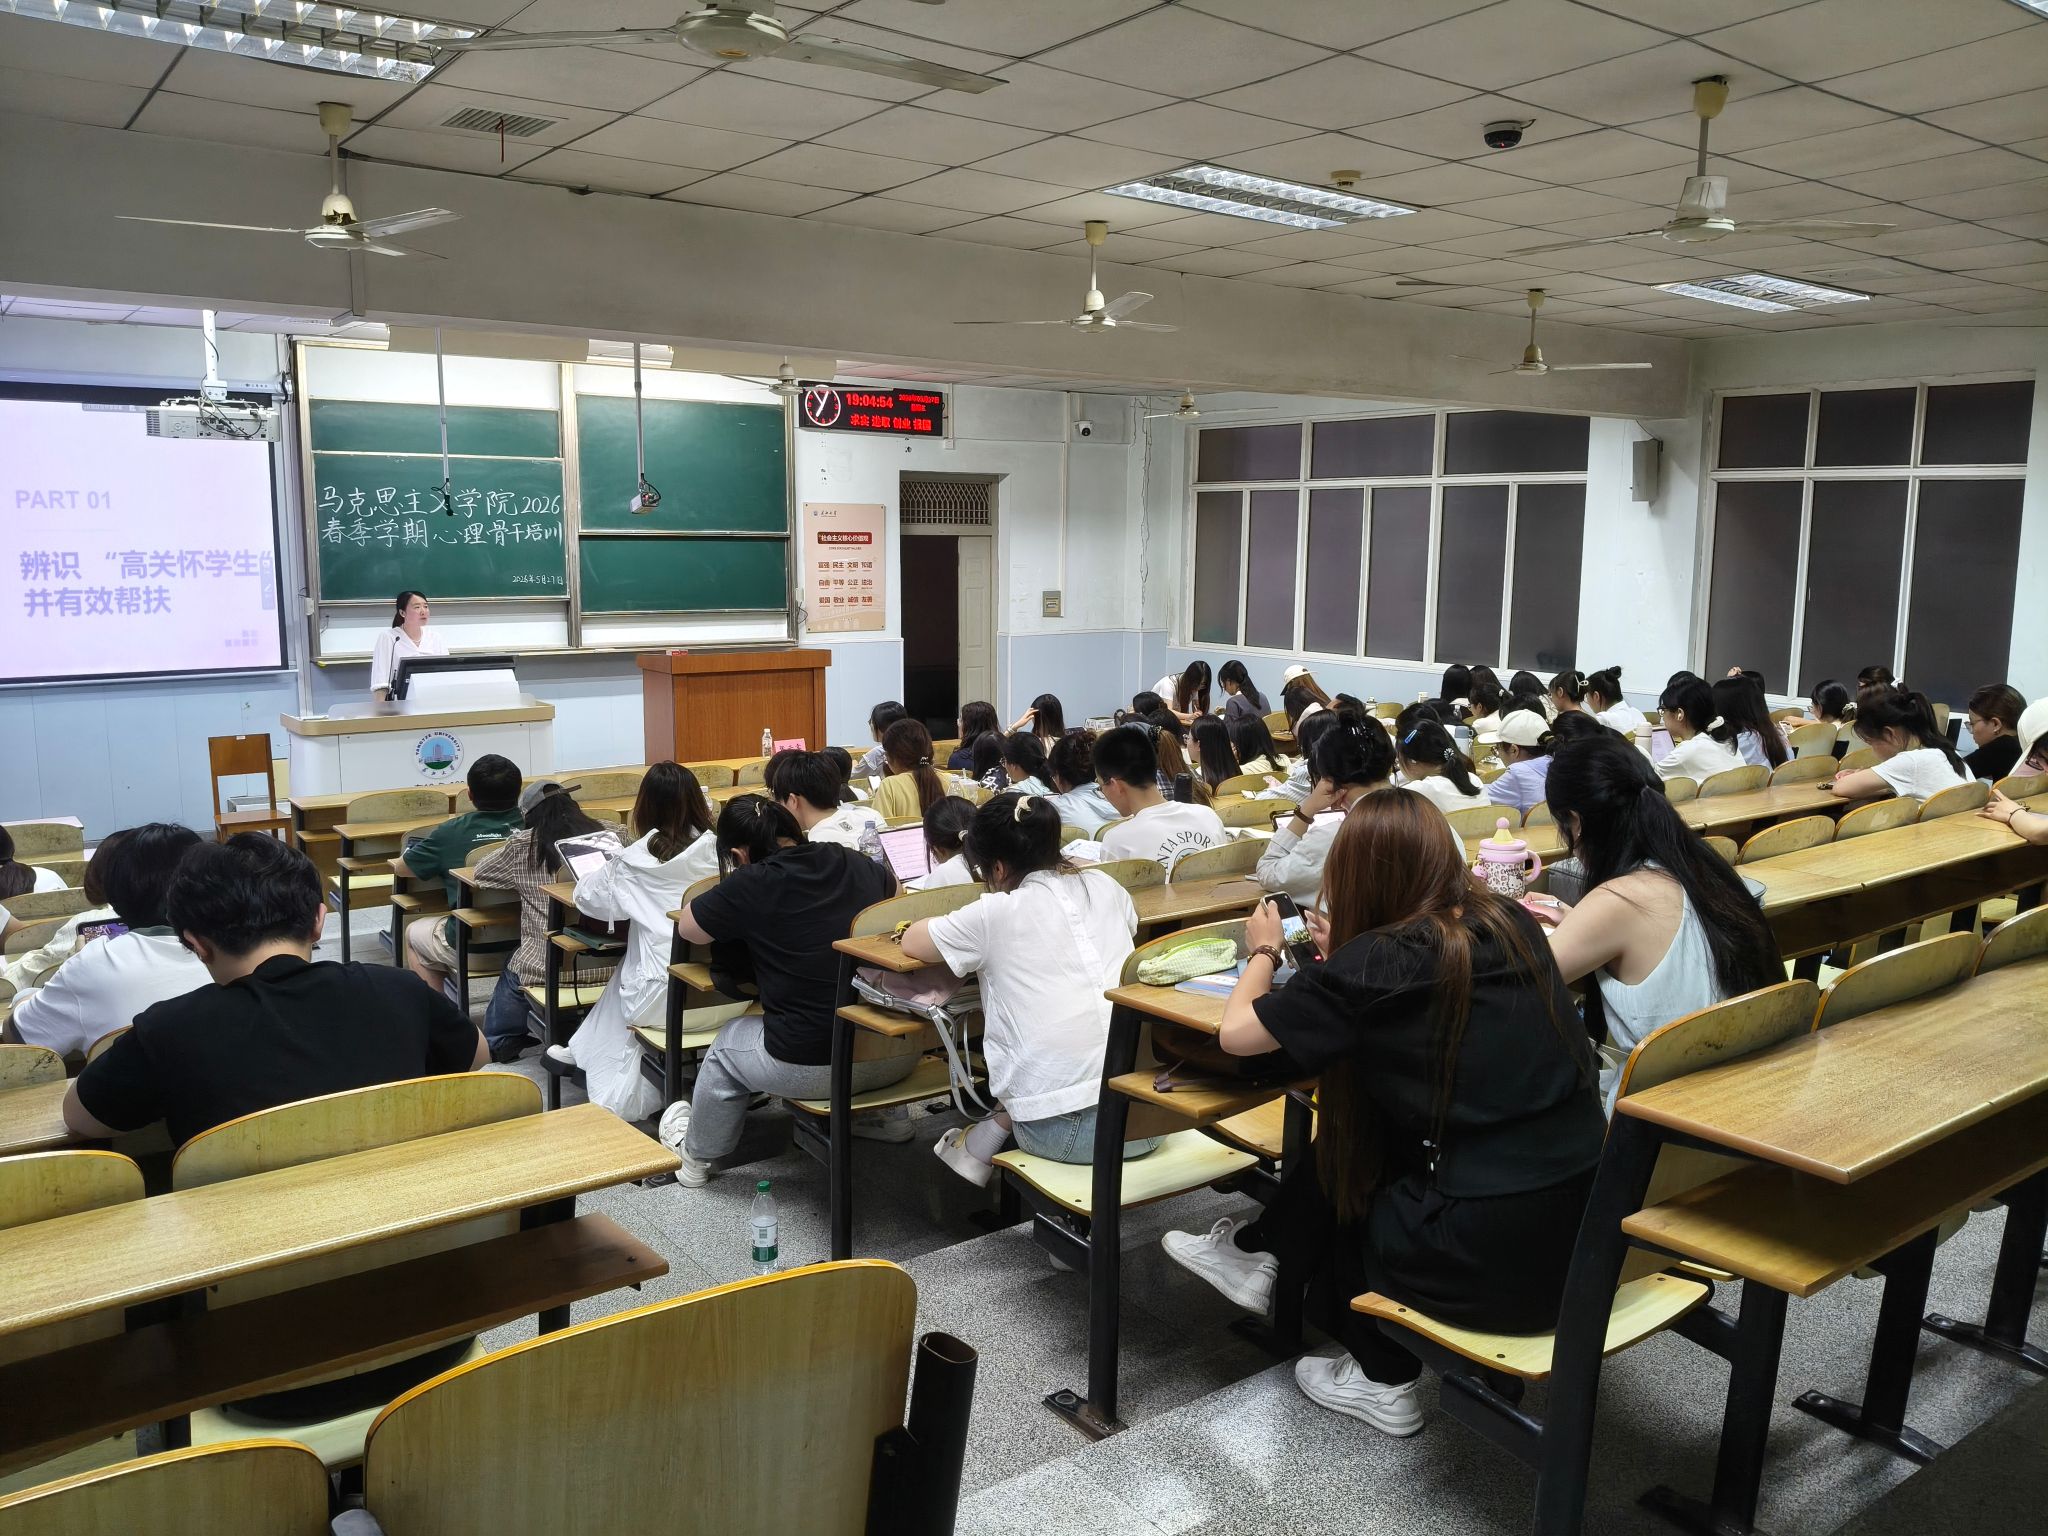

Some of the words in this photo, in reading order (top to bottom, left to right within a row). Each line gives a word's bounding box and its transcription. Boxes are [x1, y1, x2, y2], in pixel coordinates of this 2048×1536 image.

[846, 393, 893, 408] 19:04:54
[850, 414, 870, 427] 求实
[15, 490, 79, 510] PART
[87, 491, 111, 510] 01
[322, 517, 563, 548] 春季学期心理骨干培训
[20, 551, 82, 581] 辨识
[833, 561, 845, 569] 民主
[24, 586, 172, 618] 并有效帮扶
[1176, 831, 1216, 849] SPOR
